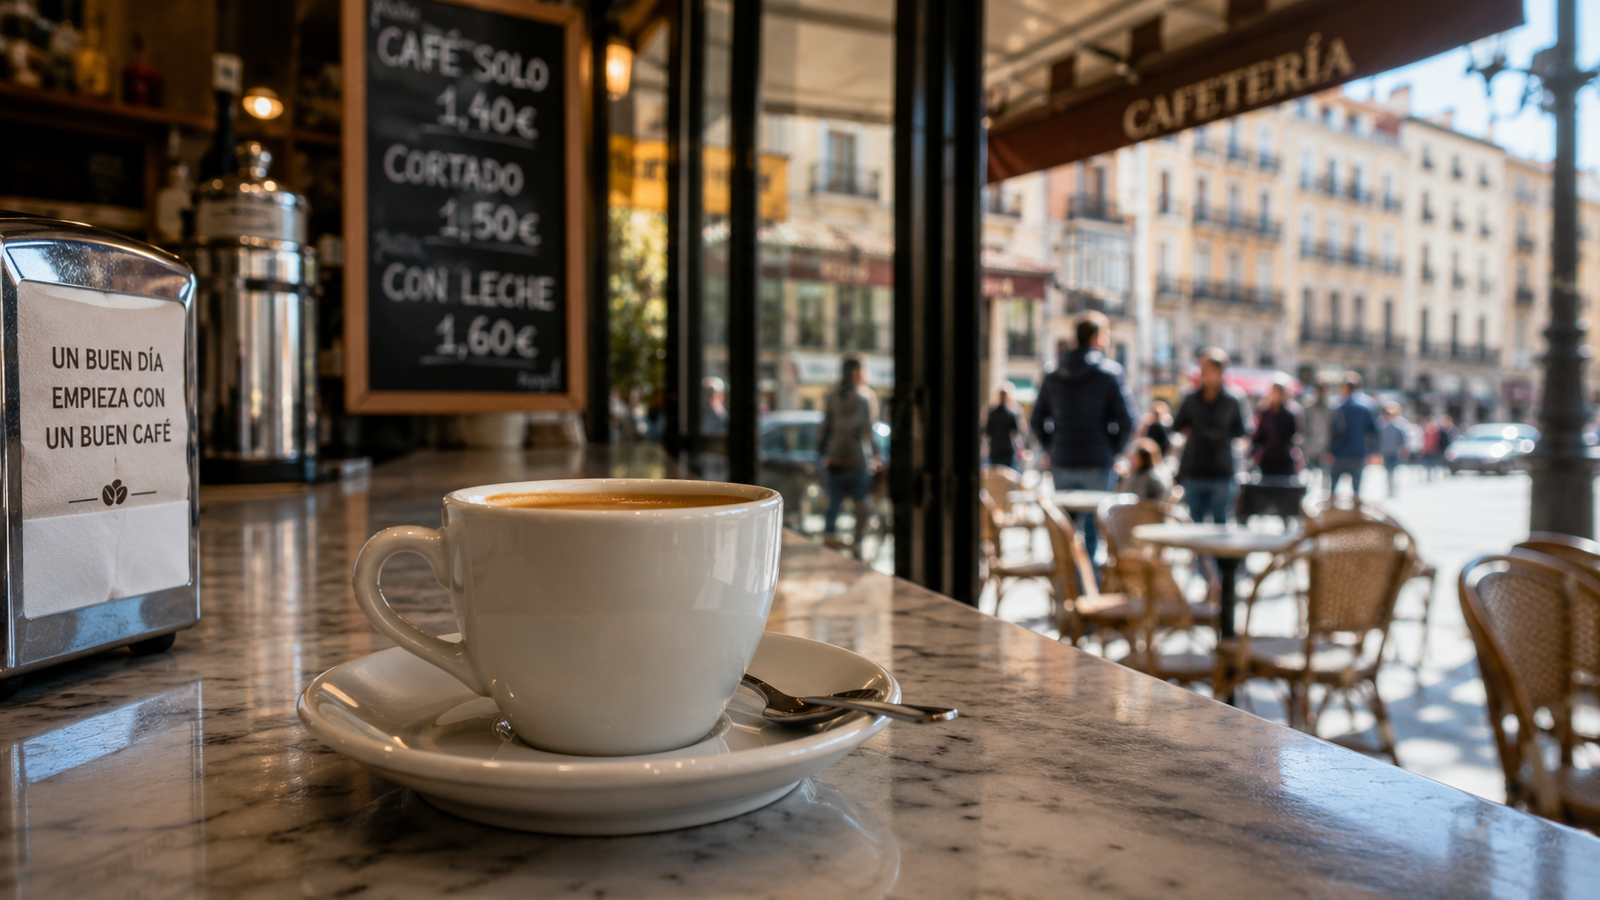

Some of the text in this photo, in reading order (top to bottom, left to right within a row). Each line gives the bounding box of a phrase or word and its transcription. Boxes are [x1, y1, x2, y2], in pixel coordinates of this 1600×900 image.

[377, 25, 549, 93] CAFÉ SOLO
[1122, 31, 1356, 140] CAFETERÍA
[436, 85, 539, 140] 1,40€
[383, 143, 525, 197] CORTADO
[438, 198, 542, 246] 1,50€
[381, 261, 556, 312] CON LECHE
[52, 346, 164, 372] UN BUEN DÍA
[435, 312, 540, 359] 1,60€
[52, 387, 165, 409] EMPIEZA CON
[46, 418, 172, 450] UN BUEN CAFÉ
